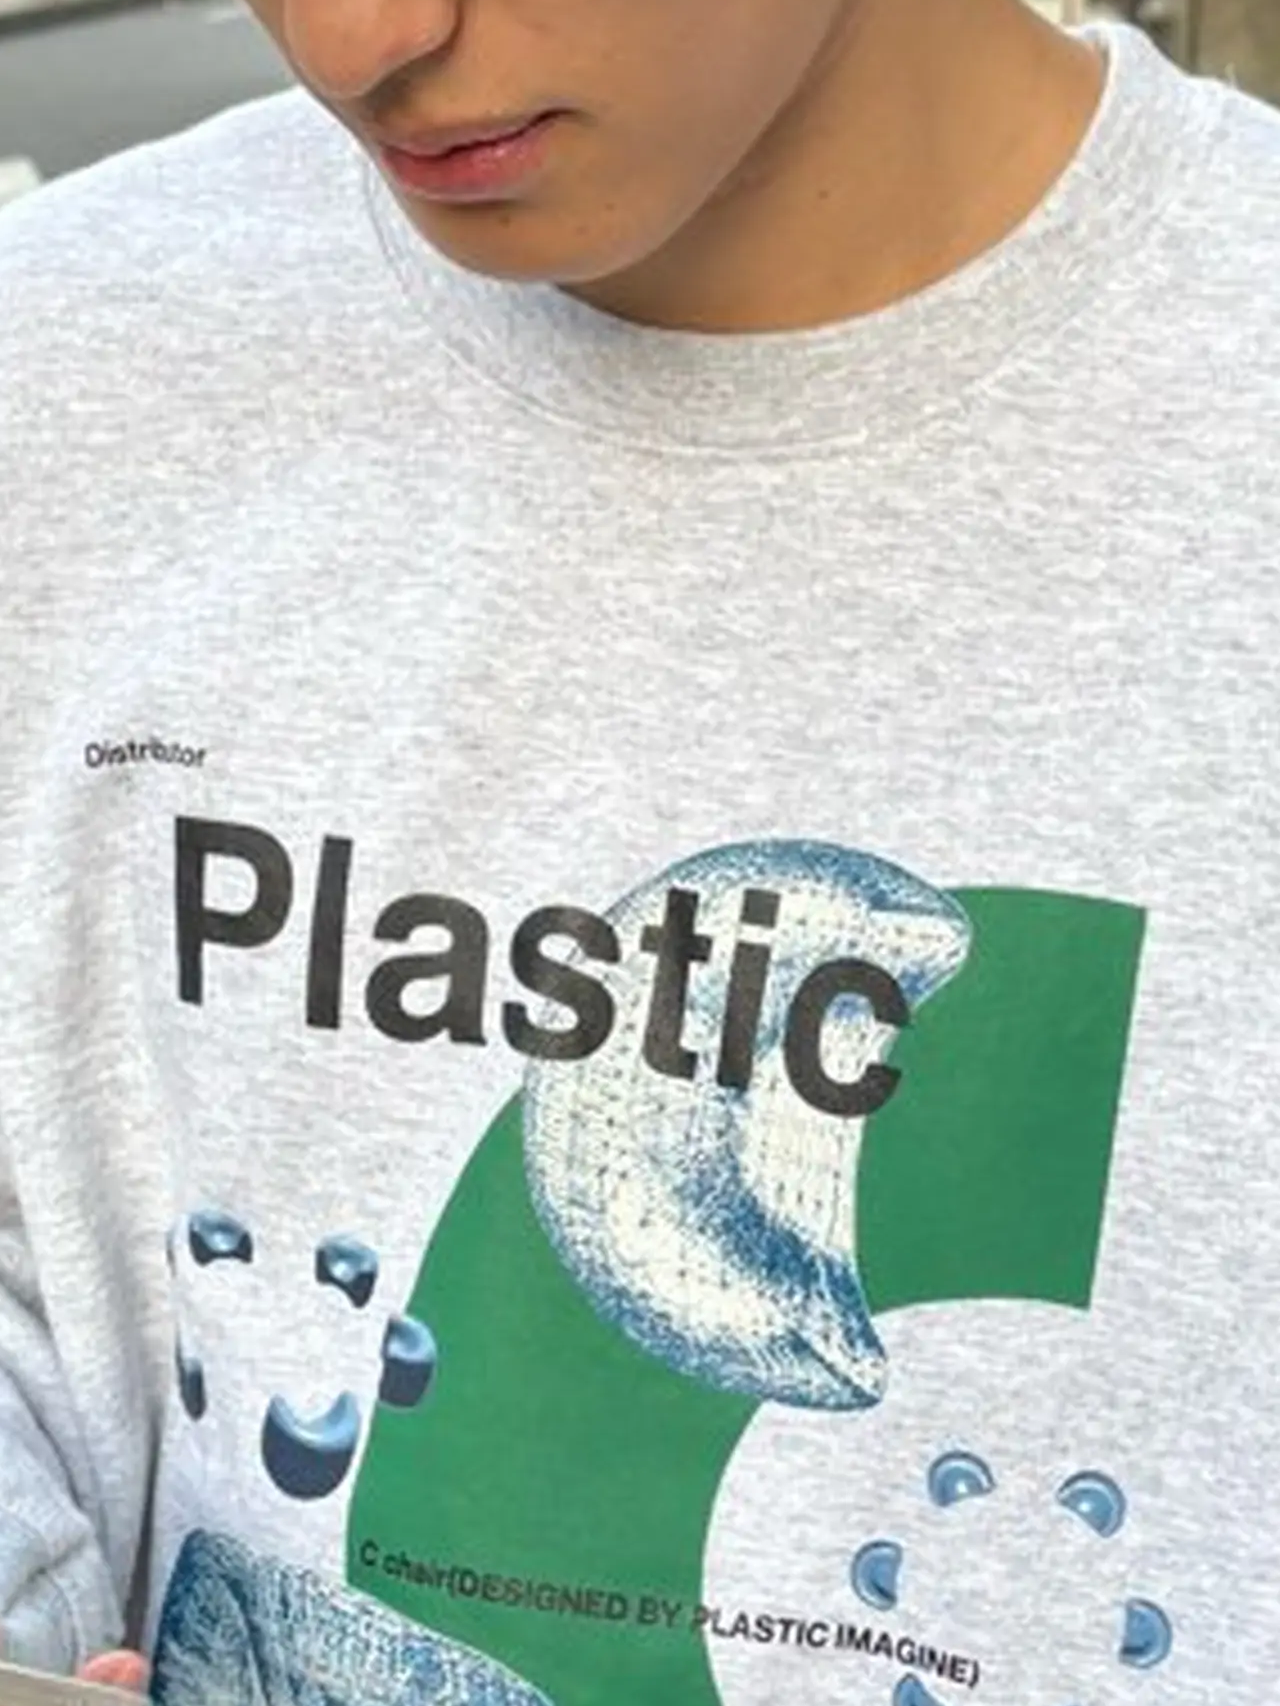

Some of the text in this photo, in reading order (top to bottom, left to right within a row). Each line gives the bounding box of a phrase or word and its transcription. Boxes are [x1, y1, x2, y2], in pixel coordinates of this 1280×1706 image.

[173, 815, 910, 1117] Plastic
[637, 1598, 685, 1630] BY
[690, 1601, 831, 1651] PLASTIC
[834, 1621, 982, 1689] IMAGINE)
